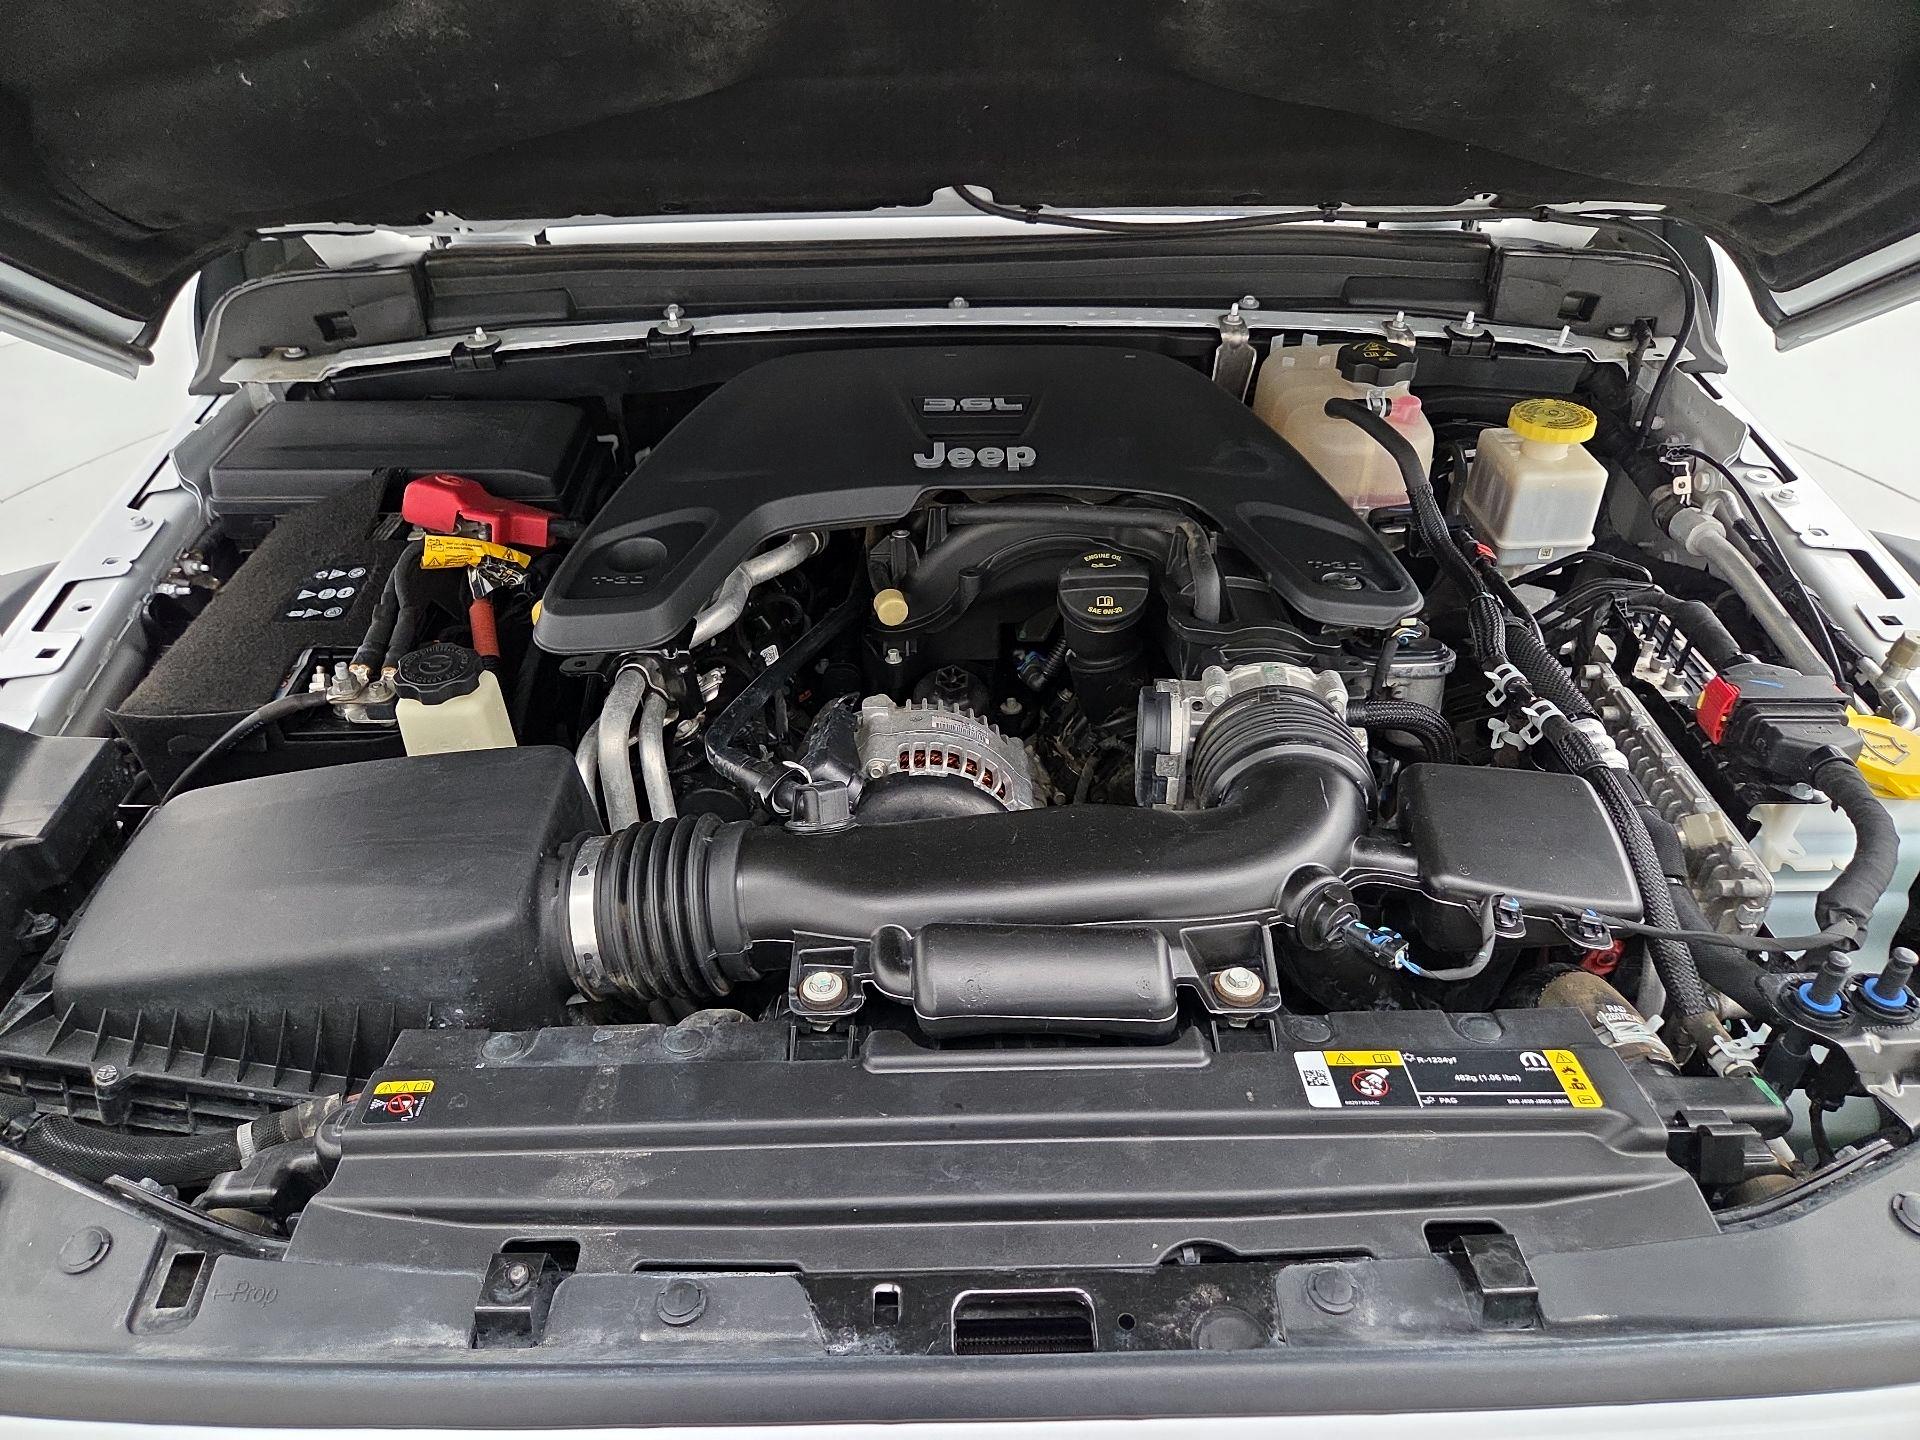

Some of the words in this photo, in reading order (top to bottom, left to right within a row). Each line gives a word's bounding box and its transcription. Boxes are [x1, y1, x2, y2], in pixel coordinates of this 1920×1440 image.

[923, 397, 1023, 412] 3.6L
[913, 441, 1037, 472] Jeep
[1083, 553, 1110, 562] ENGINE
[1111, 554, 1122, 562] OIL
[1087, 606, 1102, 615] SAE
[1438, 1096, 1458, 1105] PAG
[231, 1280, 279, 1309] Prop
